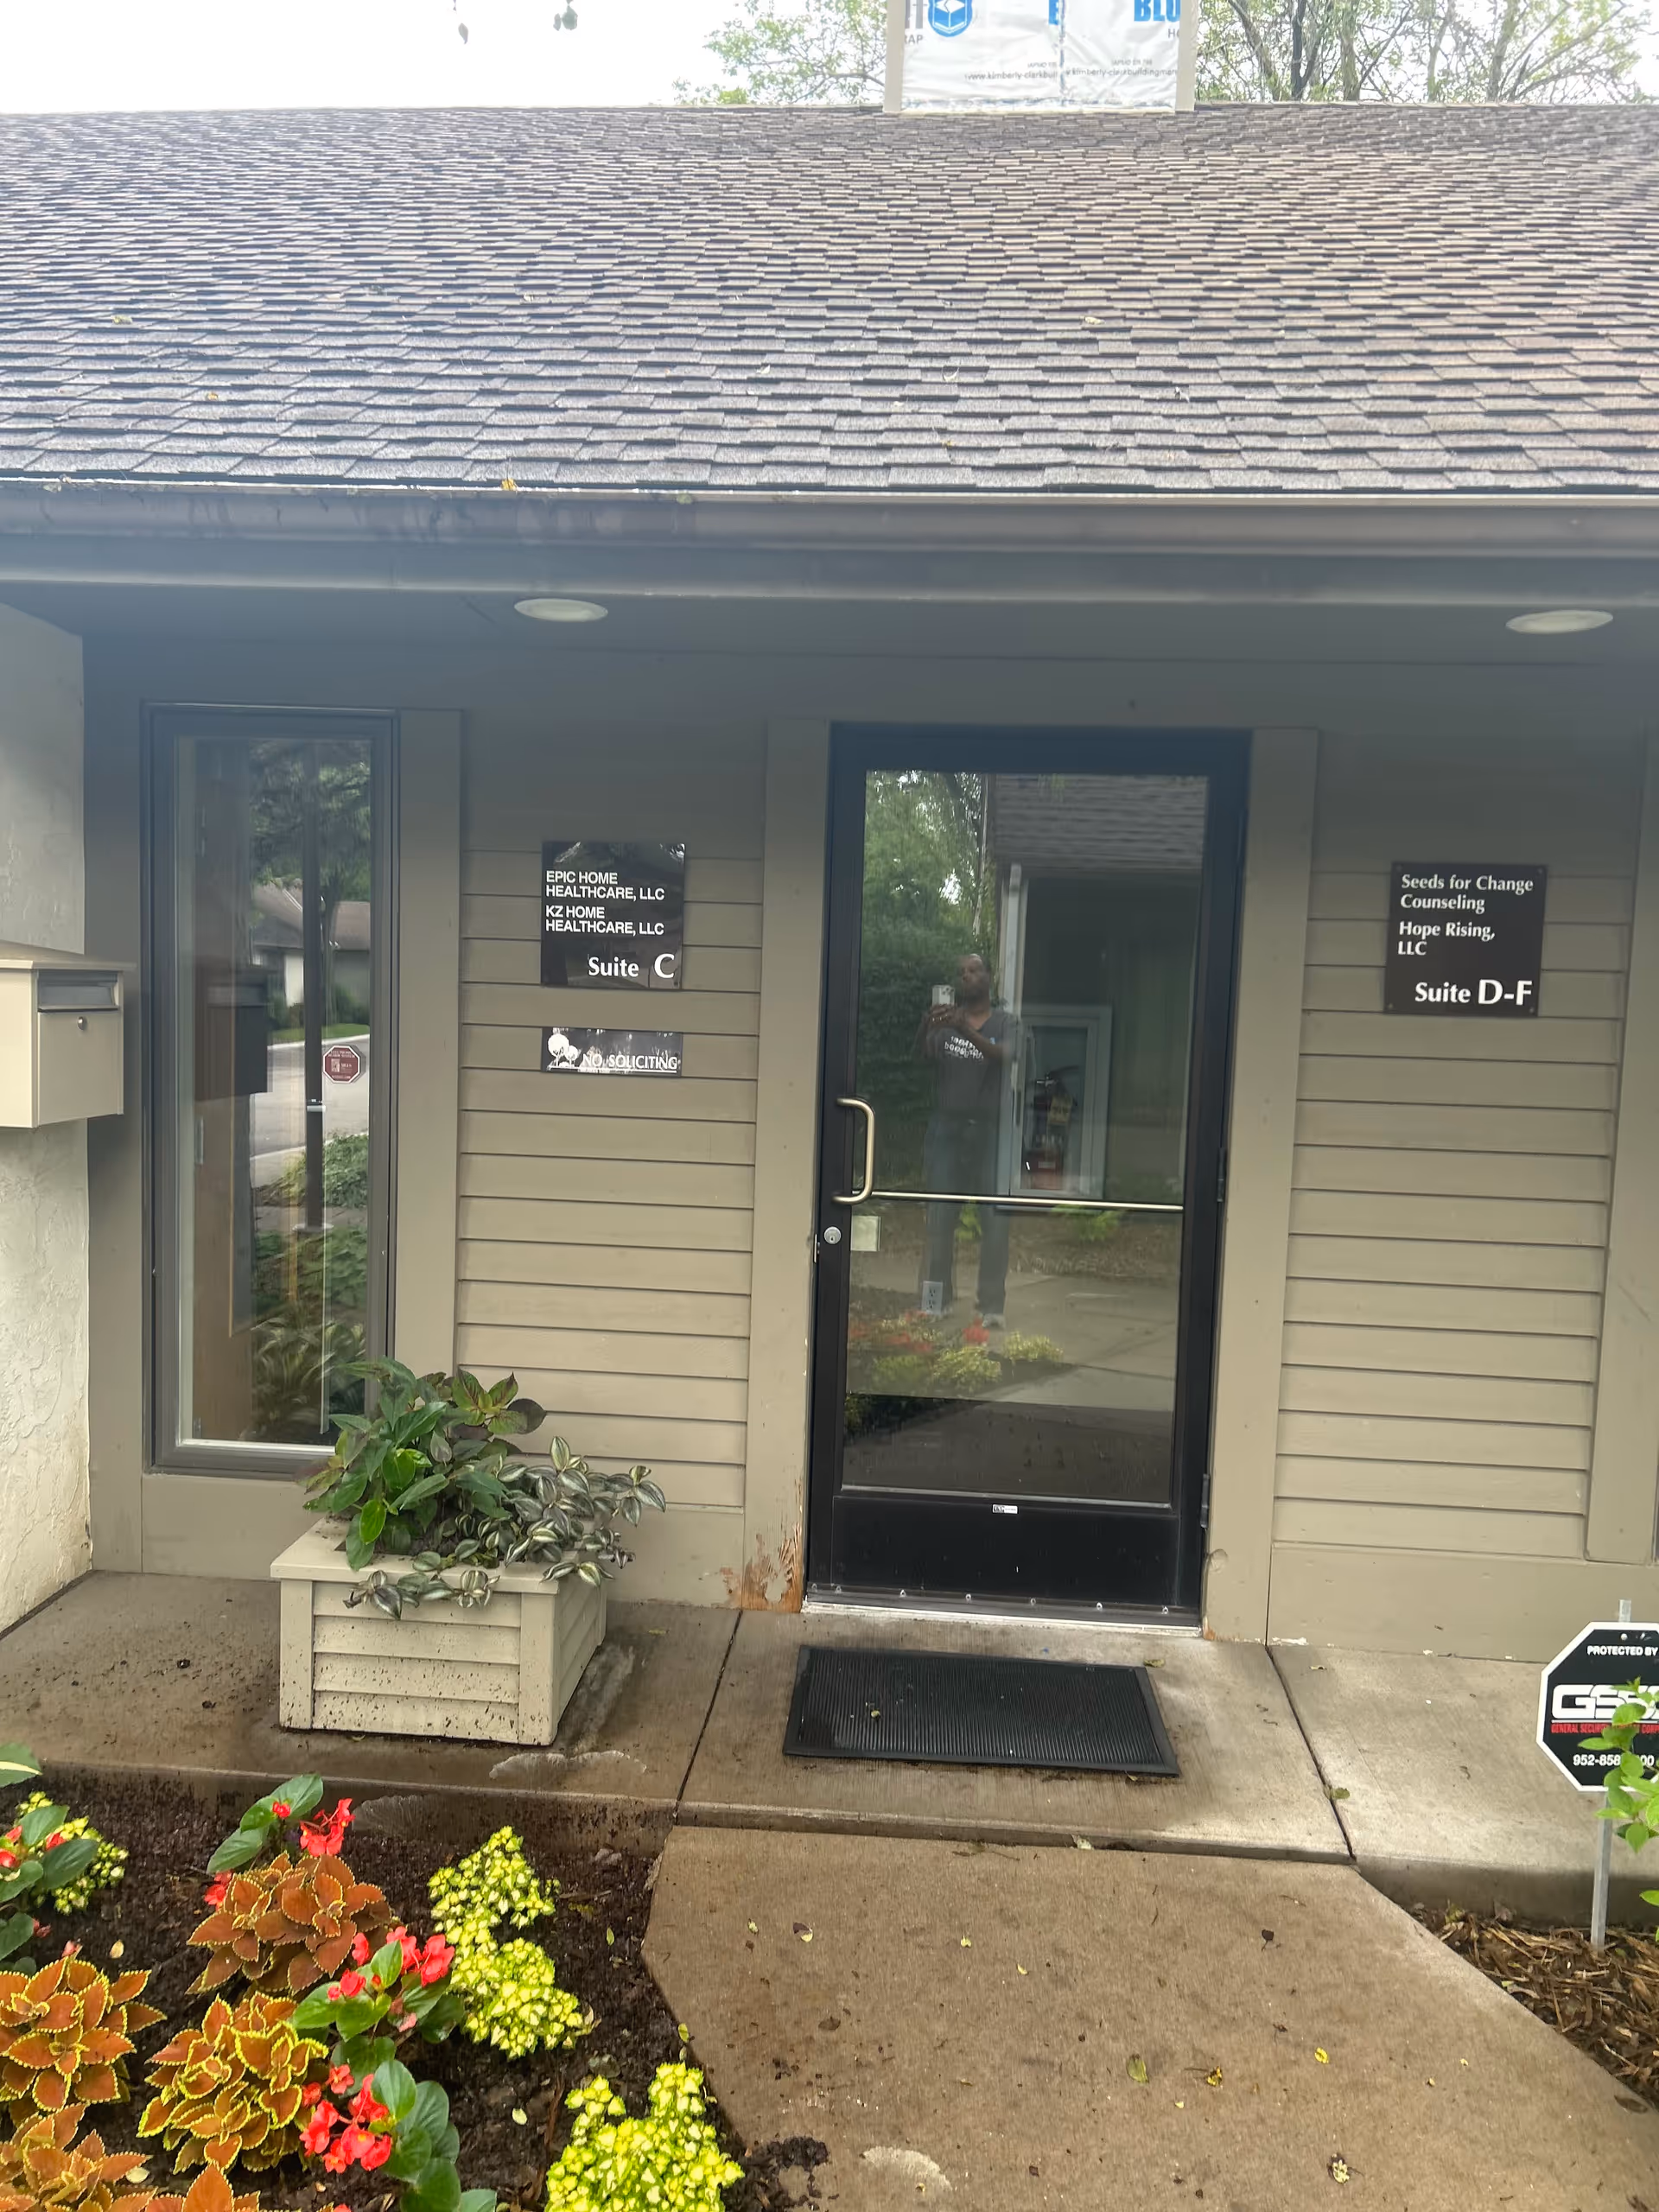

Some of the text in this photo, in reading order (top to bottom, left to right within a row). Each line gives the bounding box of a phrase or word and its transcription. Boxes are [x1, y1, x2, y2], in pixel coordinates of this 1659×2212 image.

[905, 34, 924, 45] AP
[546, 870, 618, 884] EPIC HOME
[1402, 874, 1534, 895] Seeds for Change
[546, 886, 664, 901] HEALTHCARE, LLC
[545, 905, 605, 918] KZ HOME
[1400, 893, 1485, 914] Counseling
[545, 919, 664, 936] HEALTHCARE, LLC
[1399, 921, 1495, 942] Hope Rising,
[1397, 941, 1427, 956] LLC
[588, 953, 675, 978] Suite C
[1414, 979, 1533, 1006] Suite D-F
[582, 1053, 677, 1070] NO SOLICITING
[1586, 1645, 1659, 1656] PROTECTED BY
[1551, 1723, 1579, 1733] GENERAL
